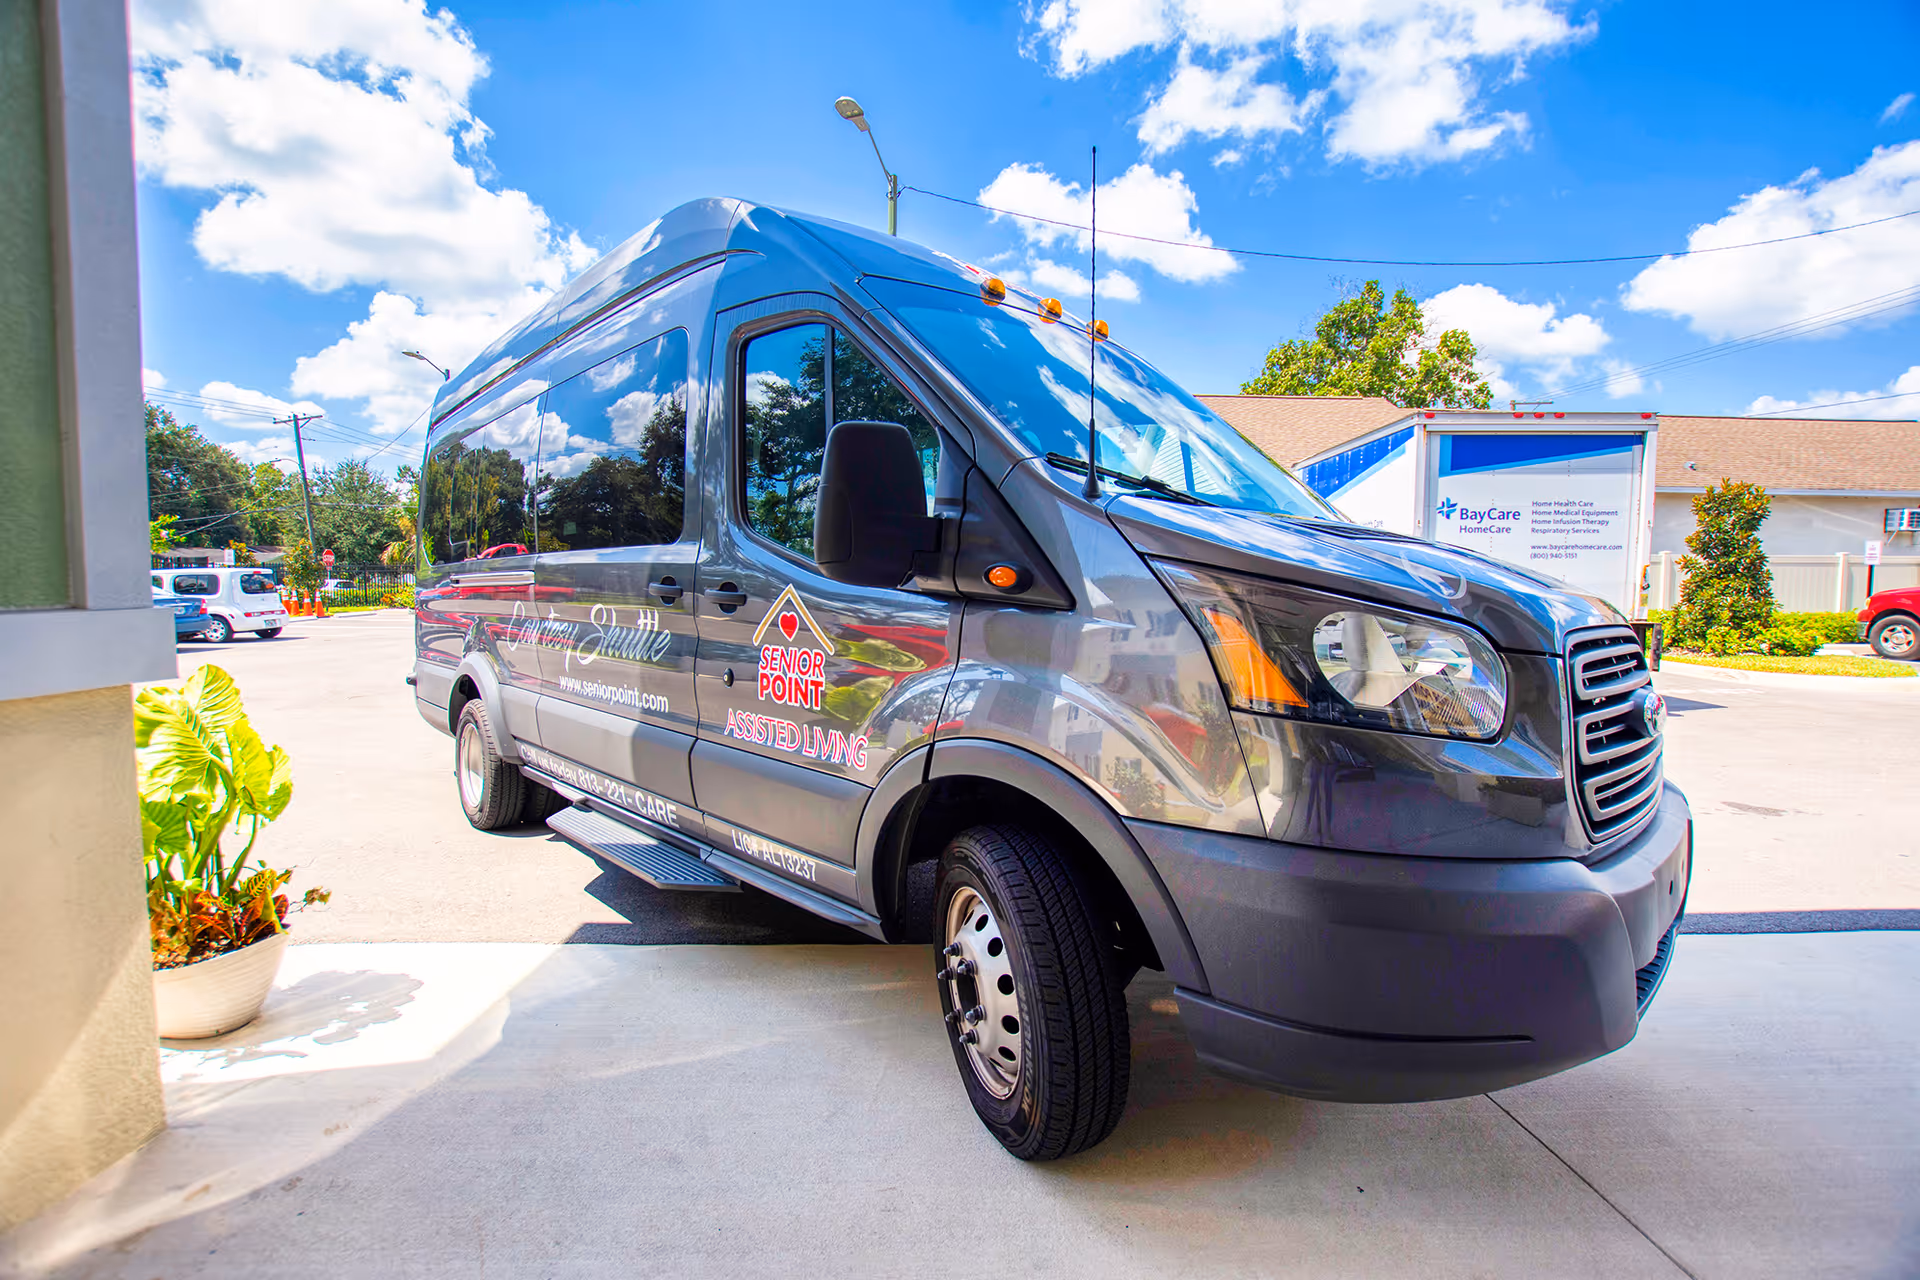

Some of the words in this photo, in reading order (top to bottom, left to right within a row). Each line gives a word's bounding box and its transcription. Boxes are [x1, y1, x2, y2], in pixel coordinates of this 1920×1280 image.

[1459, 507, 1521, 524] BayCare
[1553, 508, 1580, 516] Medical
[1581, 509, 1619, 517] Equipment
[1581, 518, 1610, 527] Therapy
[1459, 525, 1512, 534] HomeCare
[1530, 527, 1571, 535] Respiratory
[1529, 552, 1549, 560] (800)
[1549, 552, 1578, 560] 940-5151
[1530, 544, 1623, 552] www.baycarehomecare.com
[506, 600, 580, 673] Courtesy
[576, 603, 672, 666] Shuttle
[759, 645, 825, 678] SENIOR
[558, 675, 670, 713] www.seniorpoint.com
[758, 673, 825, 710] POINT
[724, 708, 801, 752] ASSISTED
[802, 724, 869, 771] LIVING
[538, 755, 549, 769] us
[549, 757, 578, 787] today
[634, 790, 680, 829] CARE
[731, 829, 759, 858] LIC#
[761, 842, 816, 882] AL13237
